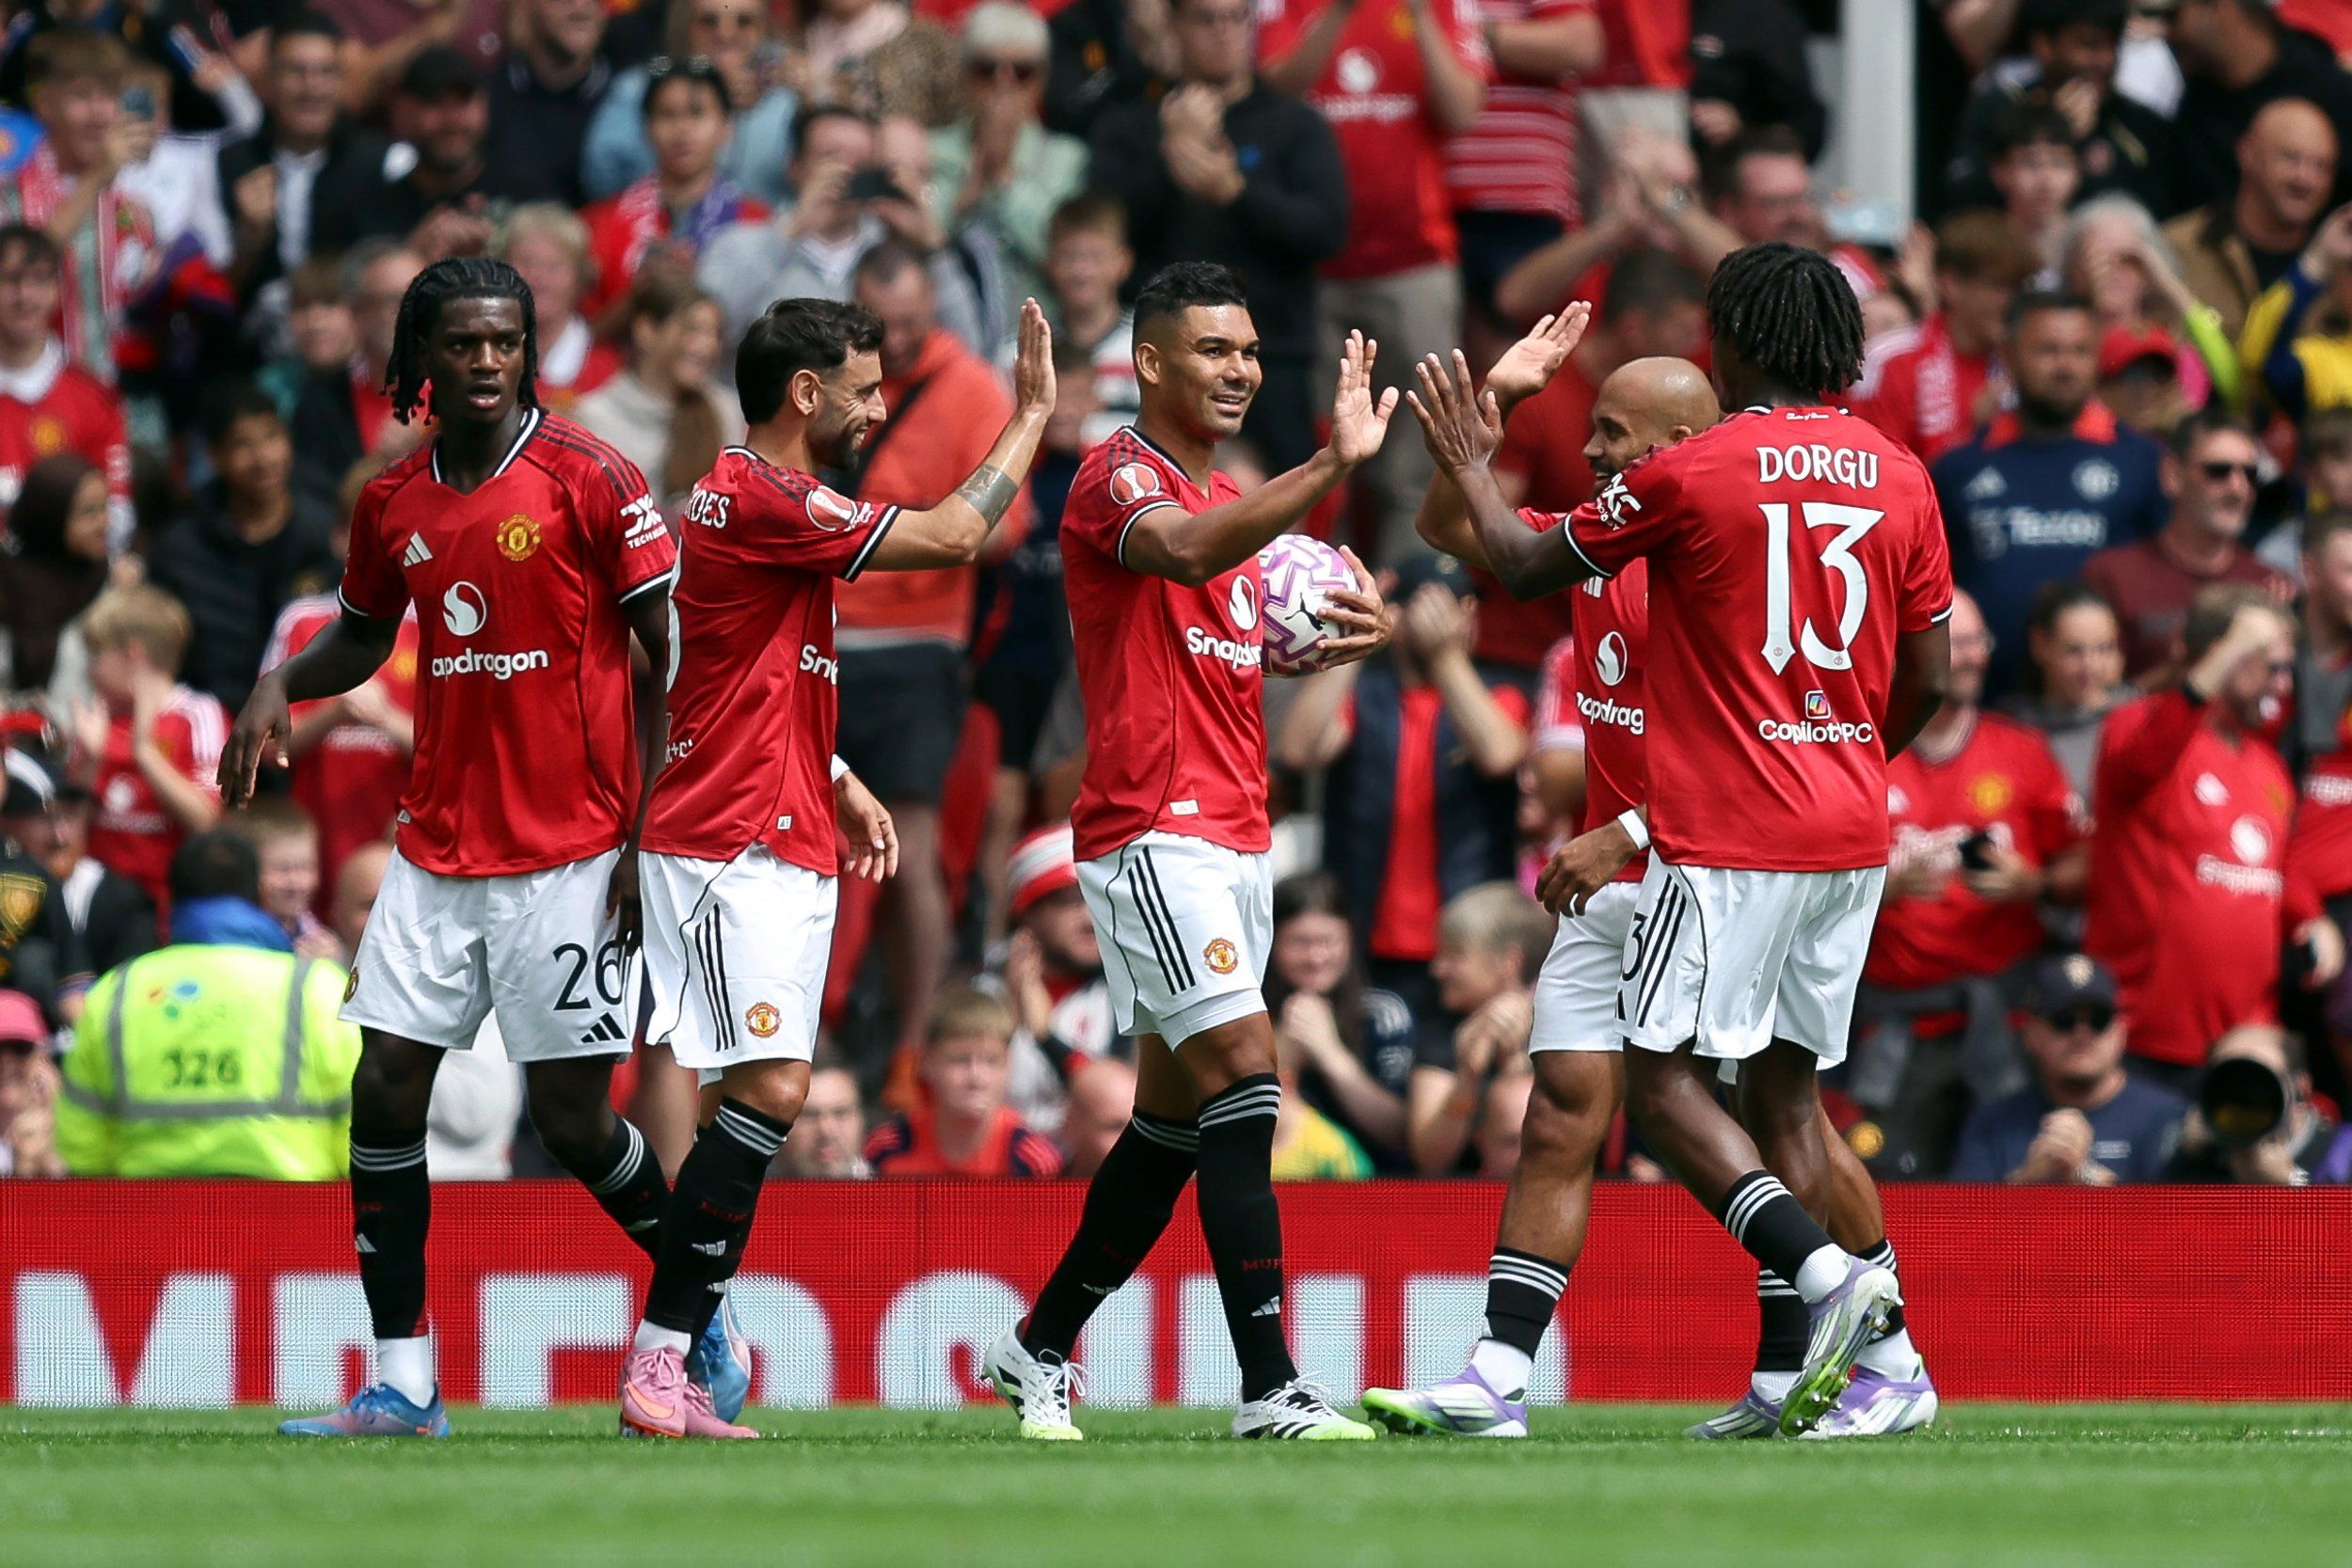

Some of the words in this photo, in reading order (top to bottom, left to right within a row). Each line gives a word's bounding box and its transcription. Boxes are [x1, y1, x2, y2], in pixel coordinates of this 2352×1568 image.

[1756, 444, 1878, 489] DORGU
[1757, 501, 1885, 676] 13
[1186, 626, 1263, 670] Snapdr
[552, 939, 626, 1011] 26
